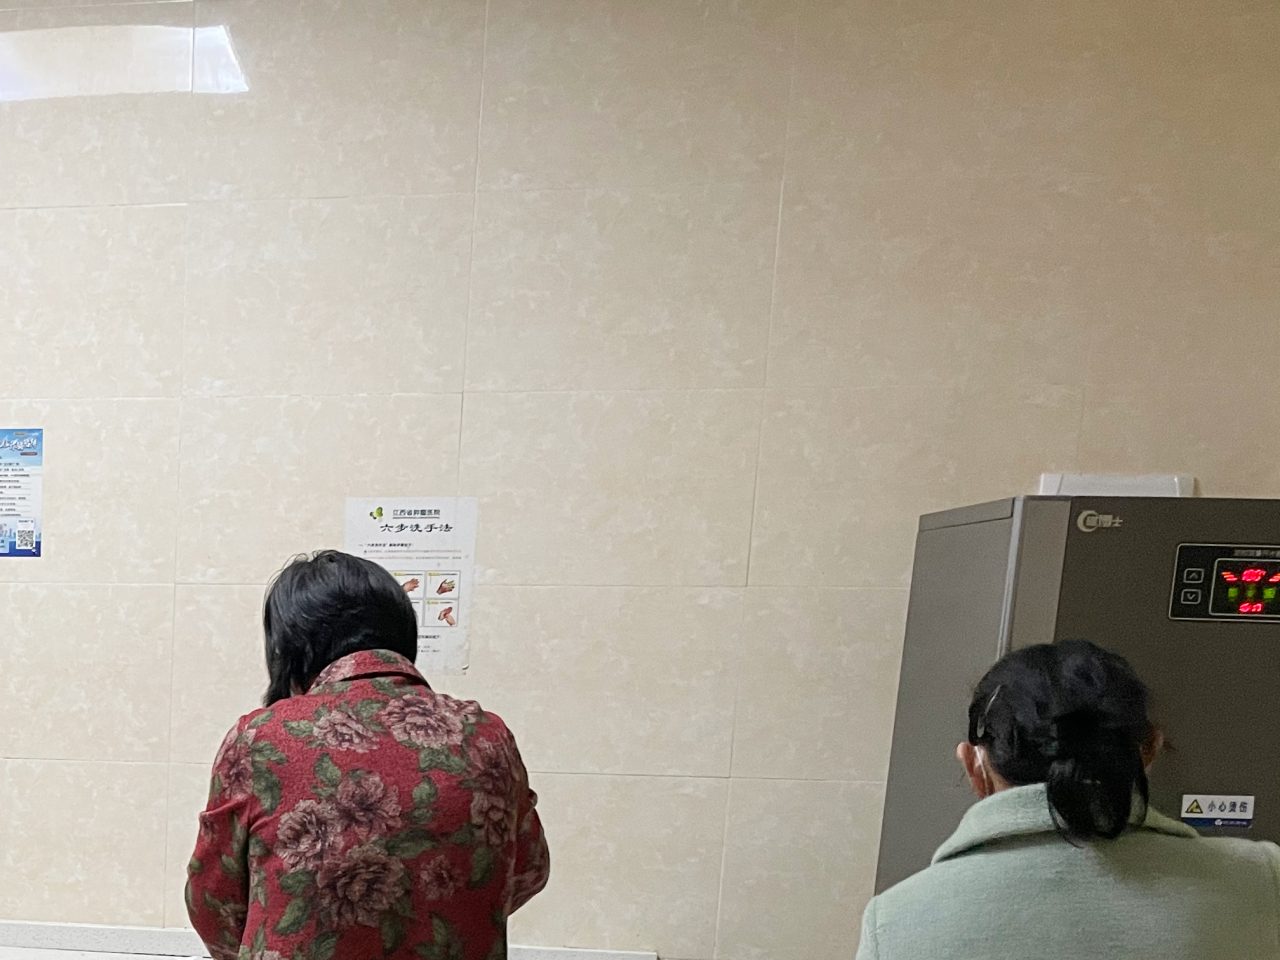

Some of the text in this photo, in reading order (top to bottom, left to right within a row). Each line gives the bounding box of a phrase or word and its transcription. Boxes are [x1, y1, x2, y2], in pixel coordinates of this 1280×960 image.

[379, 523, 454, 533] 六步洗手法
[1208, 800, 1248, 813] 小心烫伤
